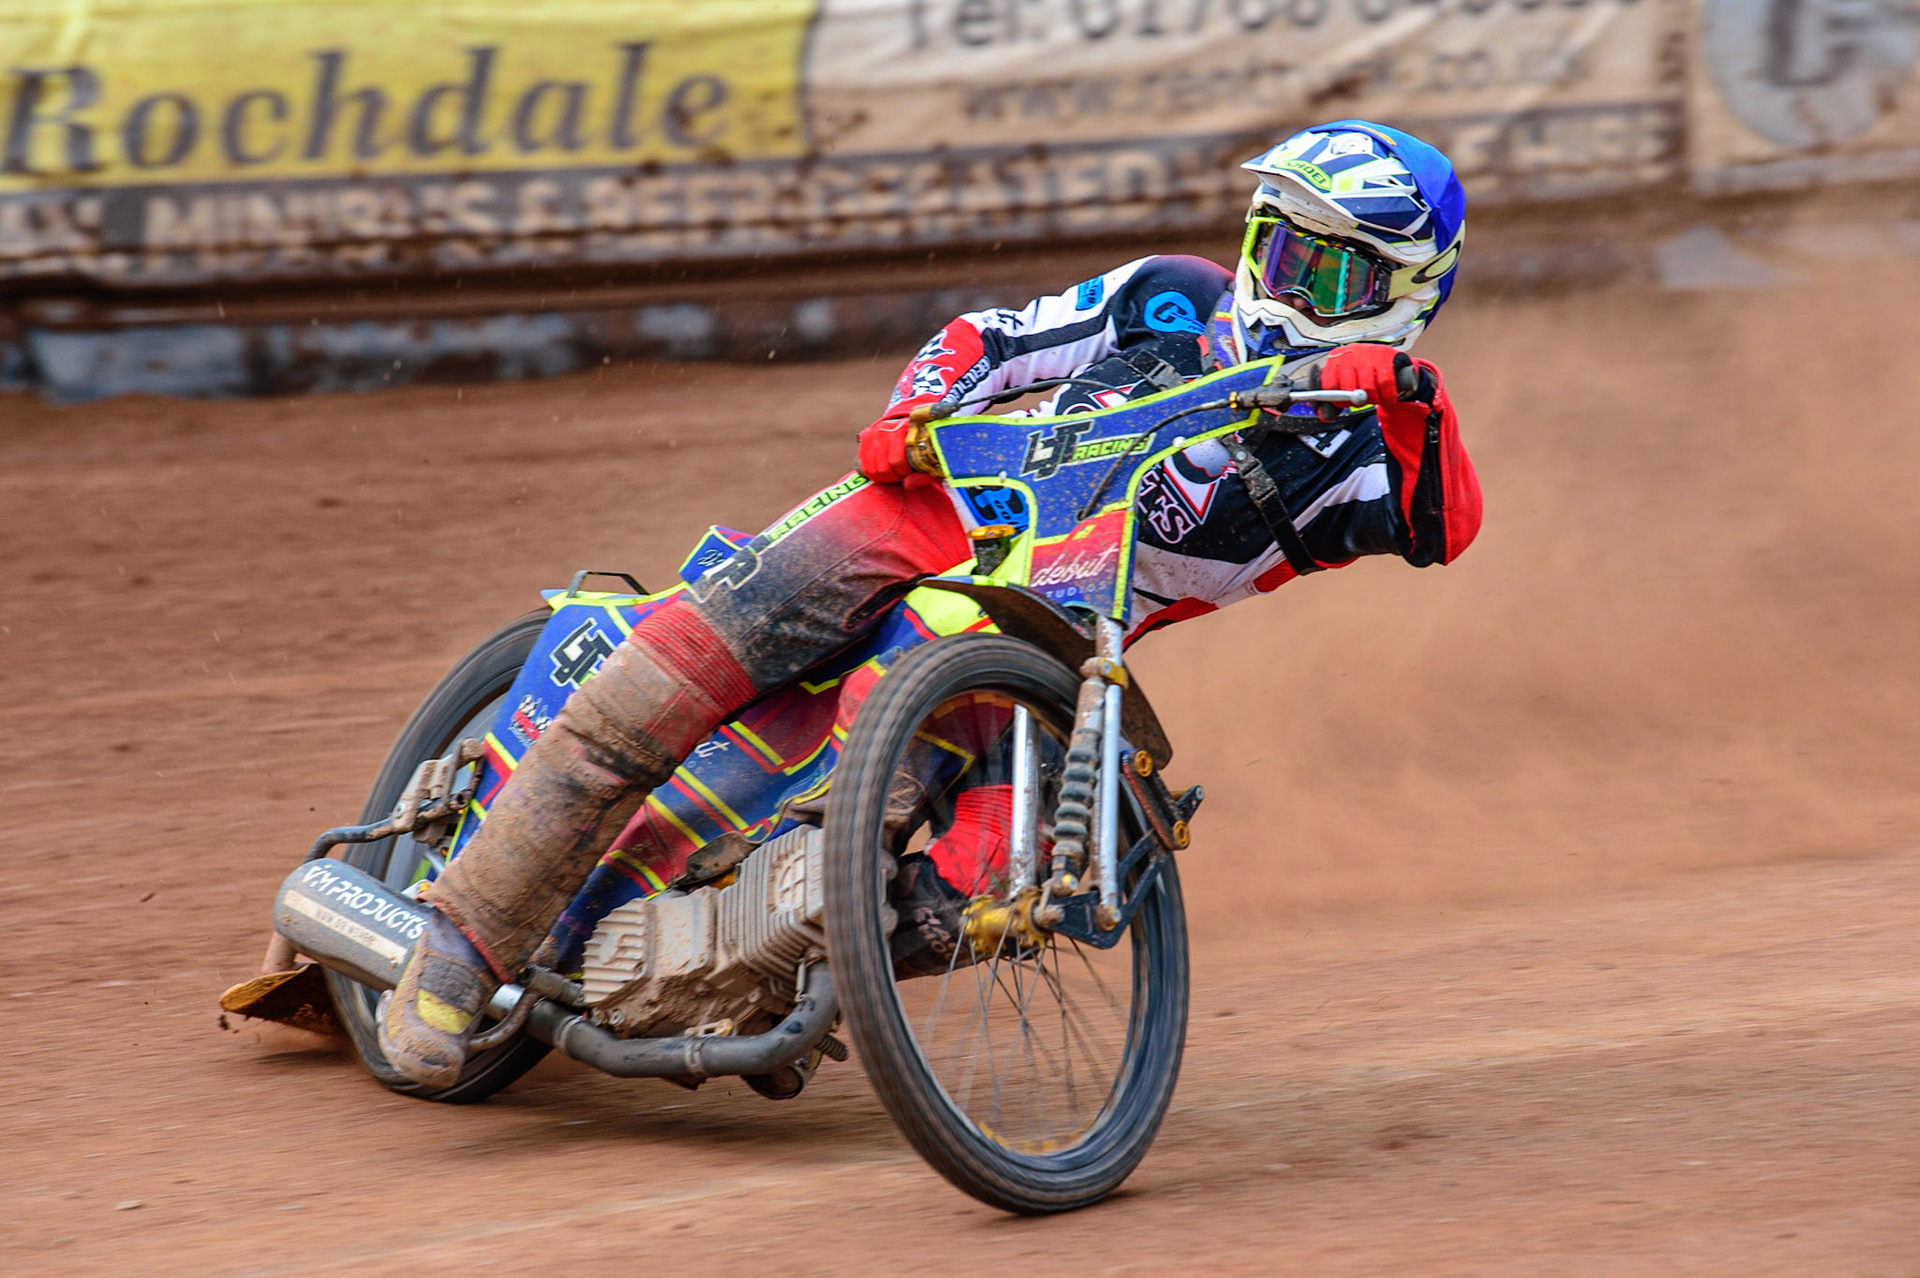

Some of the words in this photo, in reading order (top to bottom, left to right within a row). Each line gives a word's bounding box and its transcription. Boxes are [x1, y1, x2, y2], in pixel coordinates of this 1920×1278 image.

[2, 42, 730, 177] Rochdale
[769, 472, 869, 541] RACING
[1030, 542, 1120, 588] debut
[325, 880, 428, 940] PRODUCTS
